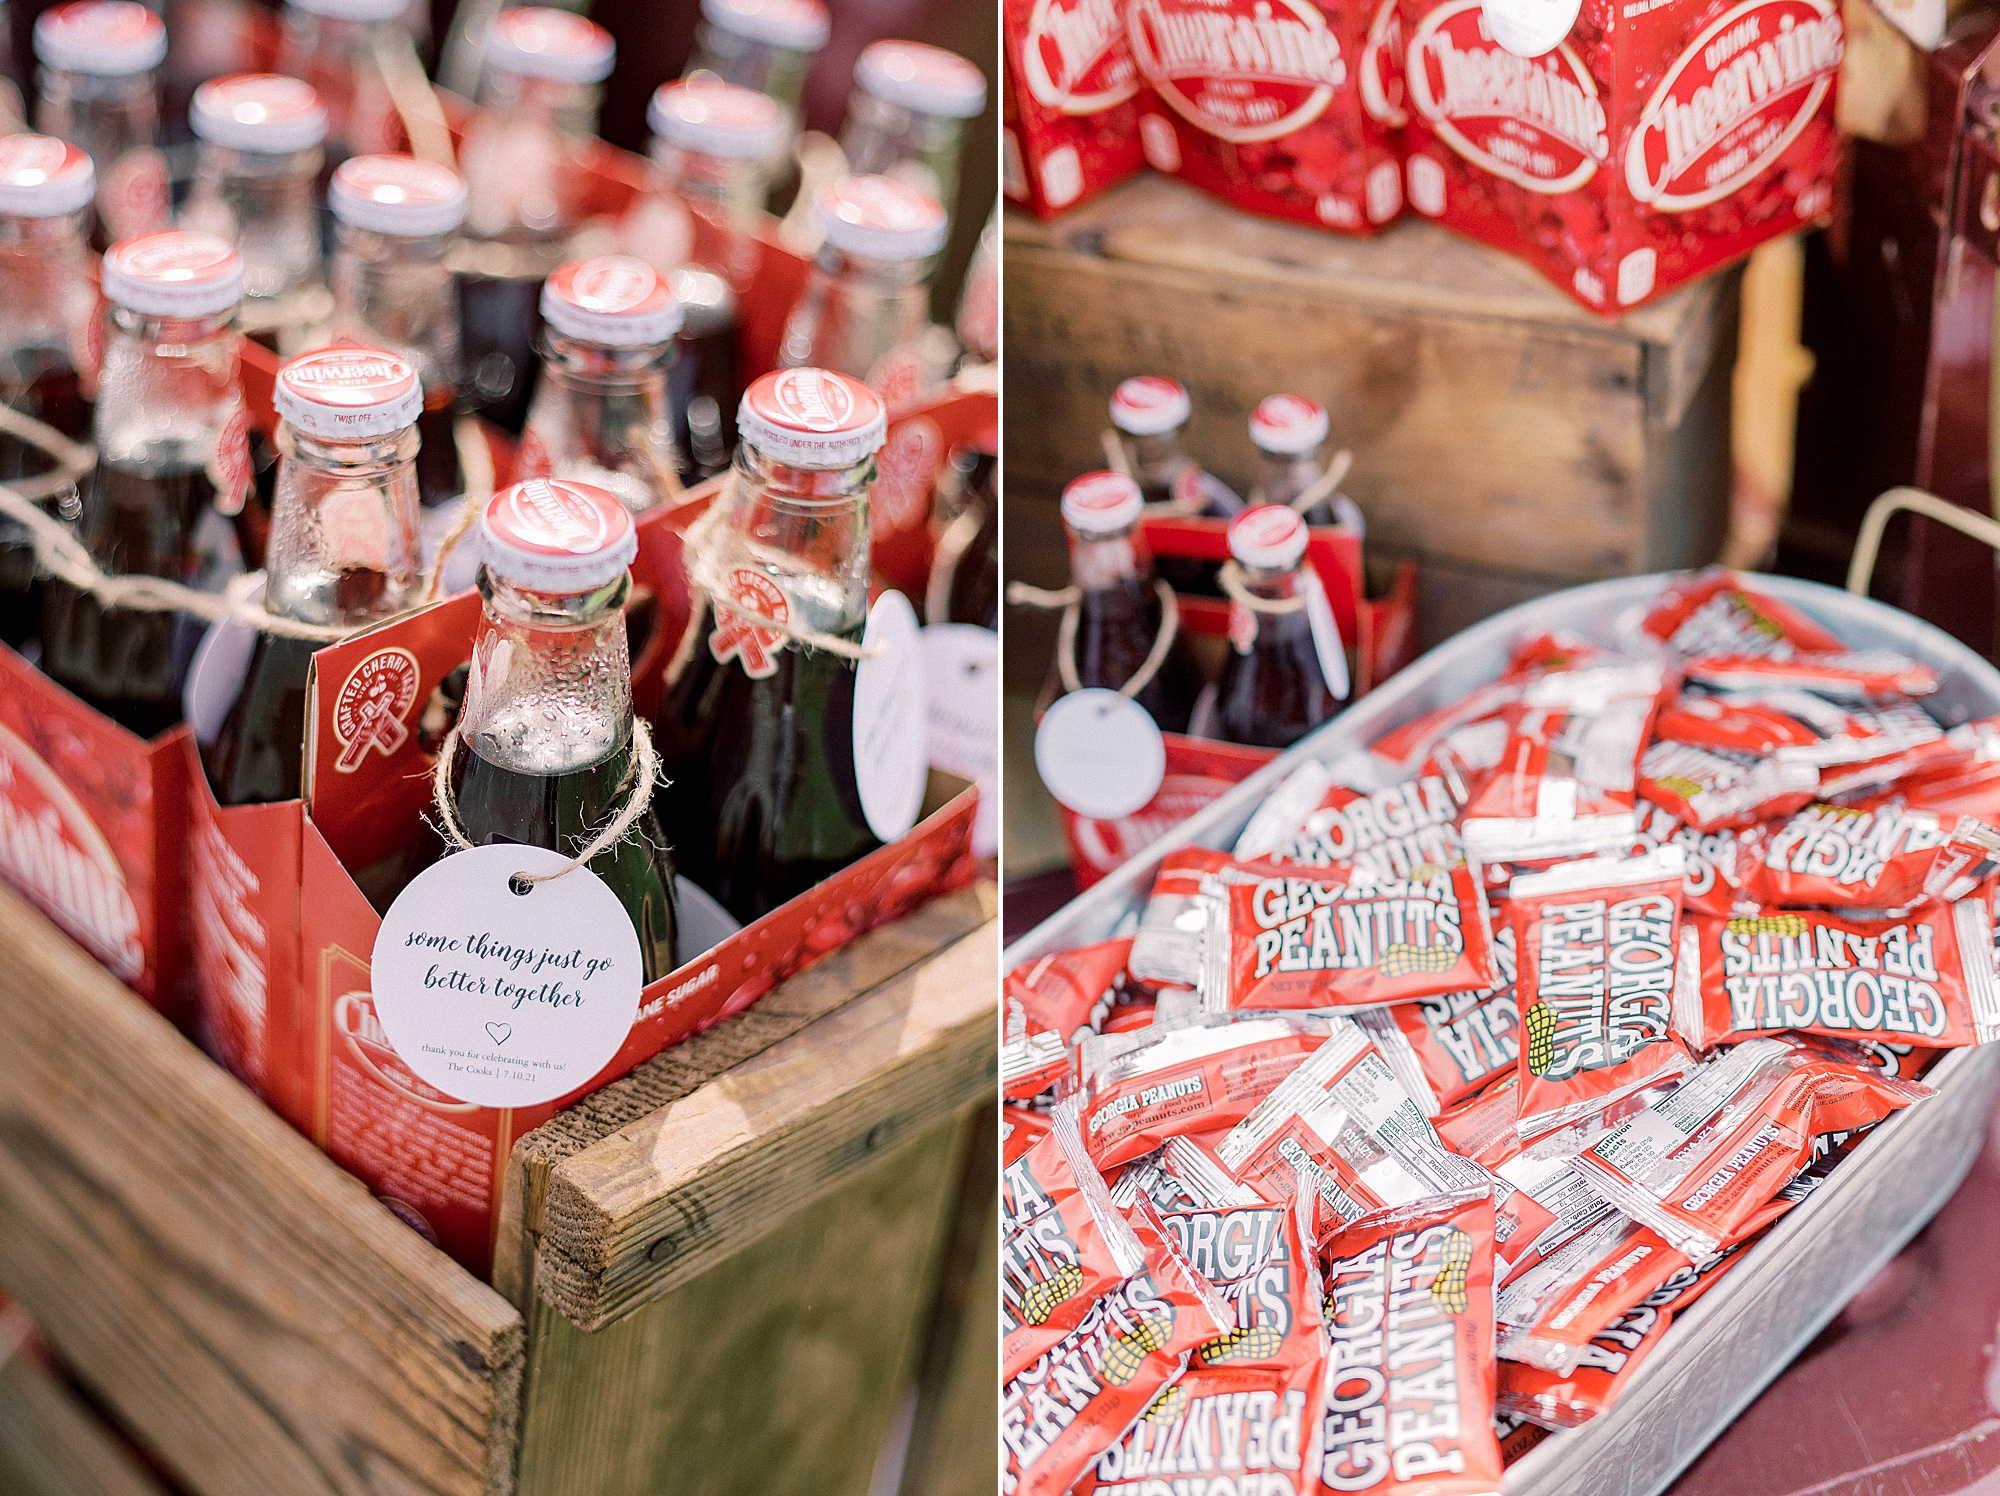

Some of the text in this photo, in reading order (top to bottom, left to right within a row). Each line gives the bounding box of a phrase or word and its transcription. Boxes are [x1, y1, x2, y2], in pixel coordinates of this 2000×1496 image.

[1624, 14, 1845, 202] Cheerwine
[334, 414, 371, 424] TWIST OFF
[763, 429, 861, 450] BOTTLED UNDER THE AUTHORITY
[340, 678, 362, 736] CRAFTED
[362, 655, 408, 678] CHERRY
[1253, 900, 1464, 979] PEANUTS
[404, 931, 615, 980] some things just go
[1721, 924, 1939, 982] PEANUTS
[423, 964, 586, 1010] better together
[1539, 900, 1607, 1076] PEANUTS
[1607, 894, 1675, 1060] GEORGIA
[632, 964, 720, 1023] ANE SUGAR
[1725, 971, 1946, 1038] GEORGIA
[421, 1043, 567, 1071] thank you for celebrating with us!
[1367, 1054, 1394, 1082] Nutrition
[447, 1062, 536, 1082] The Cooks 7.10.21
[1360, 1061, 1379, 1080] Facts
[1089, 1074, 1203, 1133] GEORGIA PEANUTS
[1163, 1098, 1182, 1109] Food
[1402, 1100, 1413, 1114] Total
[1657, 1094, 1680, 1114] Total Fat
[1828, 1097, 1838, 1105] GA
[1673, 1108, 1697, 1129] Cholest.
[1680, 1114, 1701, 1133] Sodium
[1342, 1127, 1362, 1147] 0314
[1356, 1142, 1374, 1160] JZ1
[1378, 1124, 1421, 1166] Sodium 4%
[1483, 1131, 1492, 1140] GA
[1488, 1126, 1513, 1146] PEANUT
[1594, 1121, 1633, 1155] Nutrition
[1601, 1136, 1627, 1159] Facts
[1671, 1124, 1714, 1163] 0314 JZ1
[1268, 1151, 1293, 1175] Nature's
[1384, 1117, 1402, 1135] Cholest.
[1416, 1148, 1427, 1159] 0%
[1428, 1159, 1450, 1180] Protein
[1448, 1179, 1458, 1189] 5g
[1619, 1144, 1652, 1171] Calories 120
[1629, 1149, 1655, 1170] Fat Cal. 90
[1681, 1166, 1736, 1210] GEORGIA
[1726, 1121, 1781, 1173] PEANUTS
[1440, 1158, 1467, 1184] Sugars 1g
[1558, 1187, 1588, 1208] Sugars 1g
[1566, 1178, 1586, 1193] rotein
[1320, 1176, 1366, 1222] PEANUTS
[1558, 1194, 1593, 1218] Dietary Fiber
[1586, 1197, 1604, 1211] Total
[1500, 1218, 1512, 1228] USA
[1569, 1207, 1588, 1221] Carb.
[1009, 1332, 1034, 1358] (21g)
[1388, 1225, 1466, 1481] PEANUTS
[1321, 1240, 1390, 1491] GEORGIA
